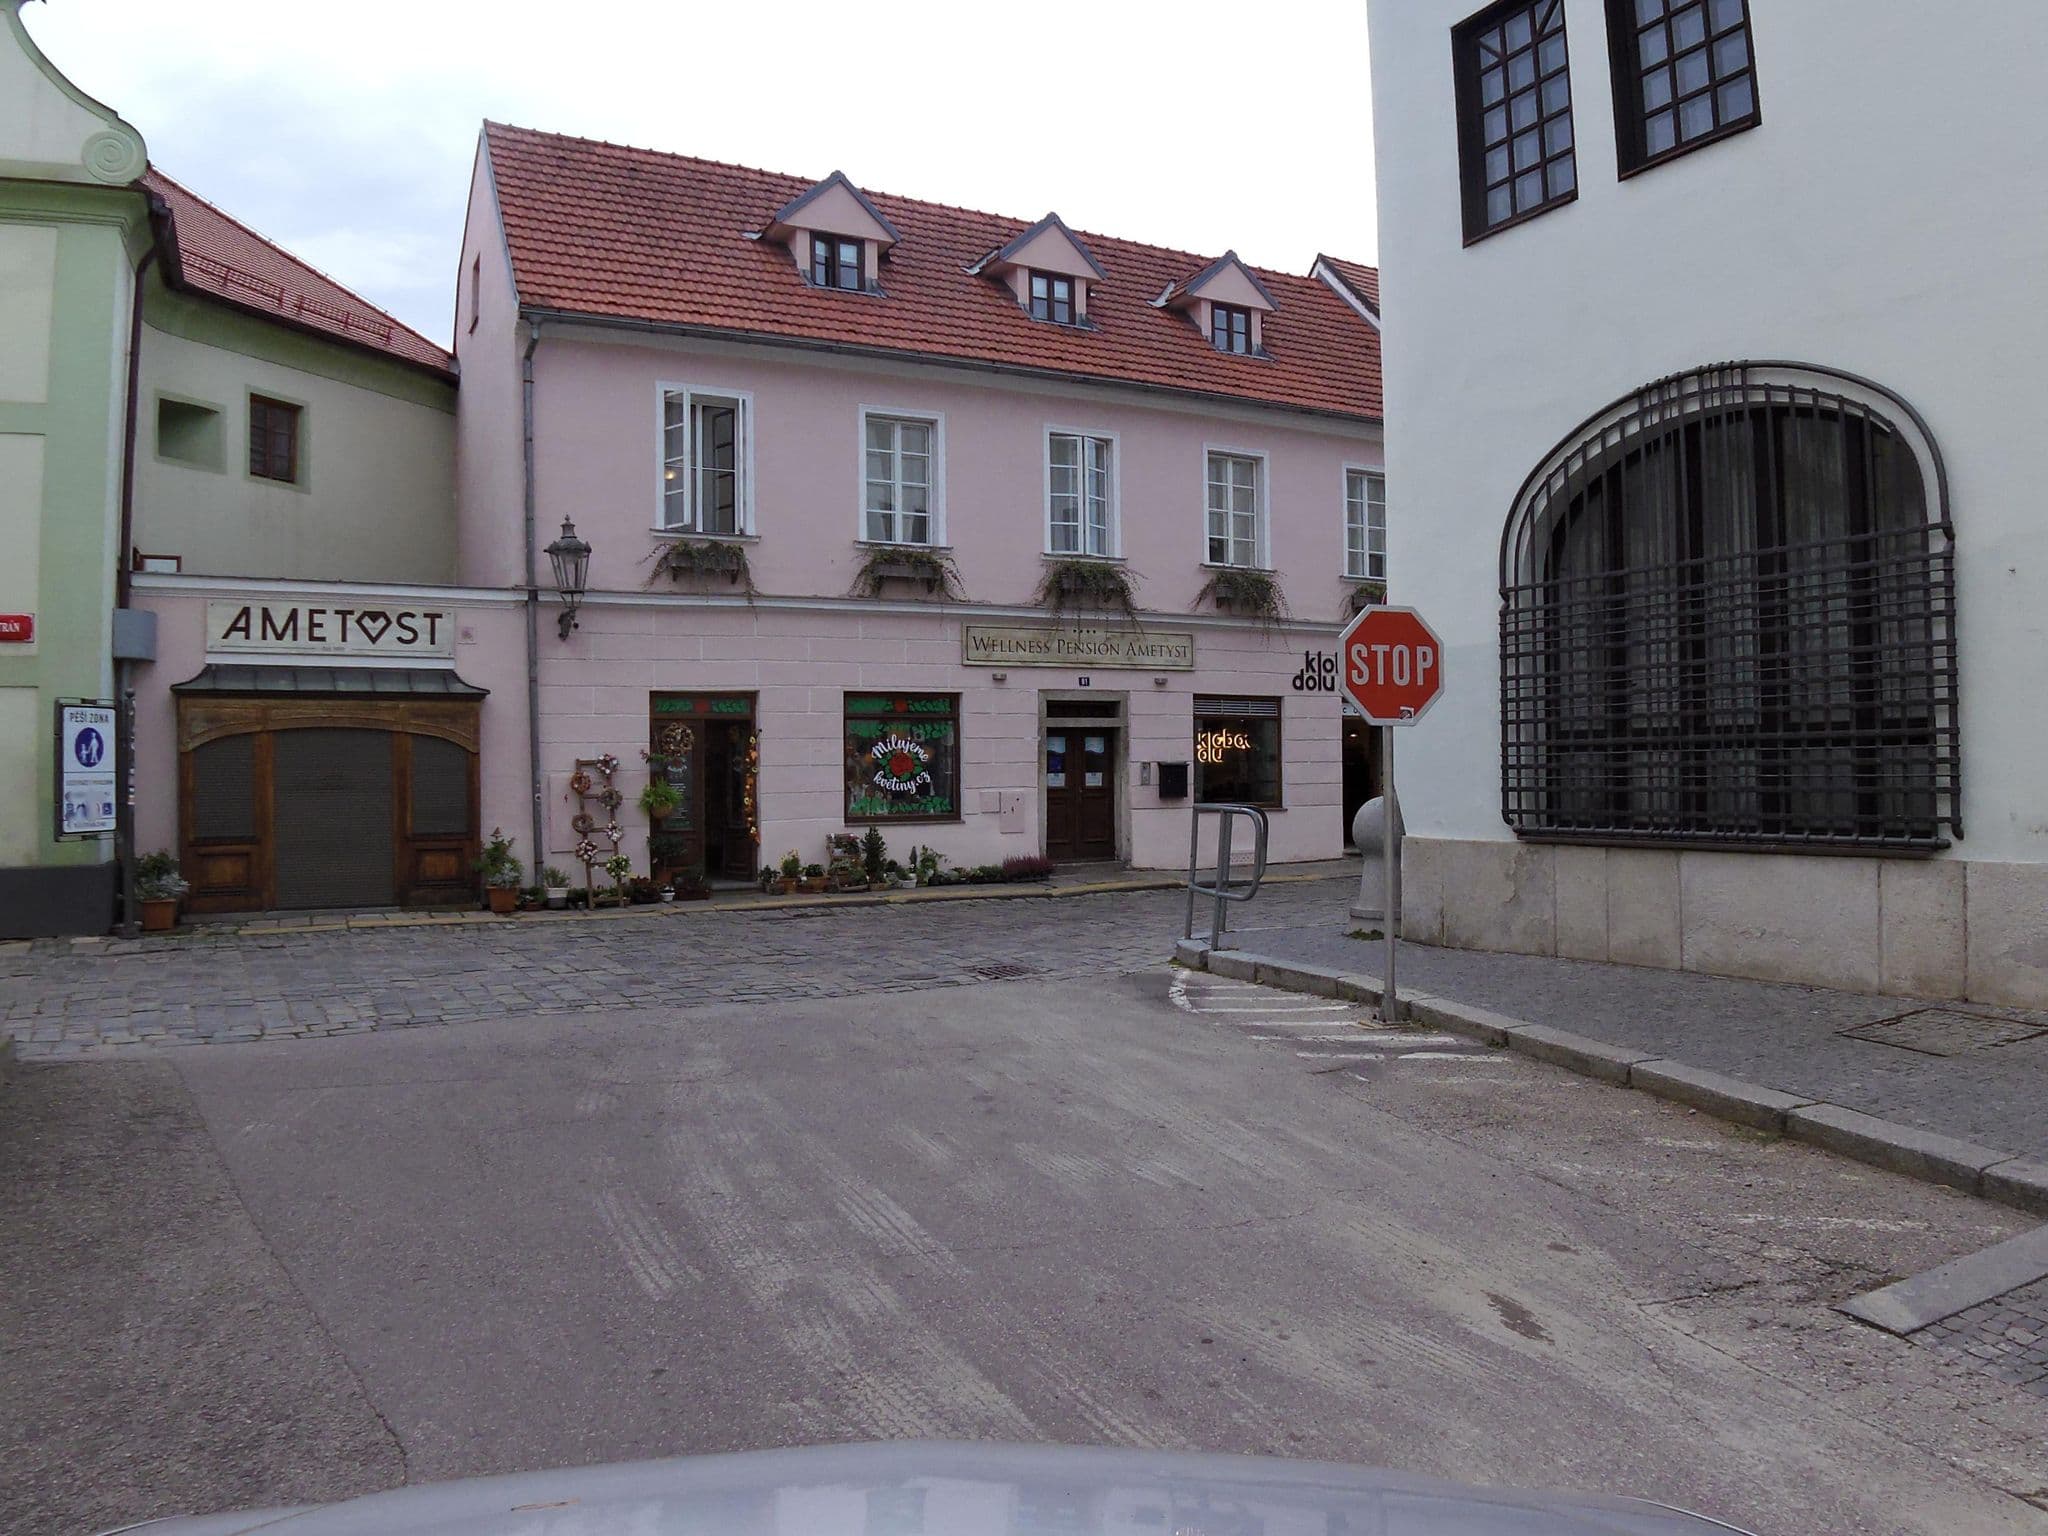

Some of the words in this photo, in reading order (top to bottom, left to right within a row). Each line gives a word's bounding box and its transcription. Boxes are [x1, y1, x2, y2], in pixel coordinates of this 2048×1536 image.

[972, 635, 1050, 654] WELLNESS
[1057, 639, 1119, 656] PENSION
[1126, 642, 1188, 659] AMETYST
[1351, 643, 1434, 686] STOP
[1292, 668, 1335, 691] dolu
[872, 733, 929, 761] Milujeme
